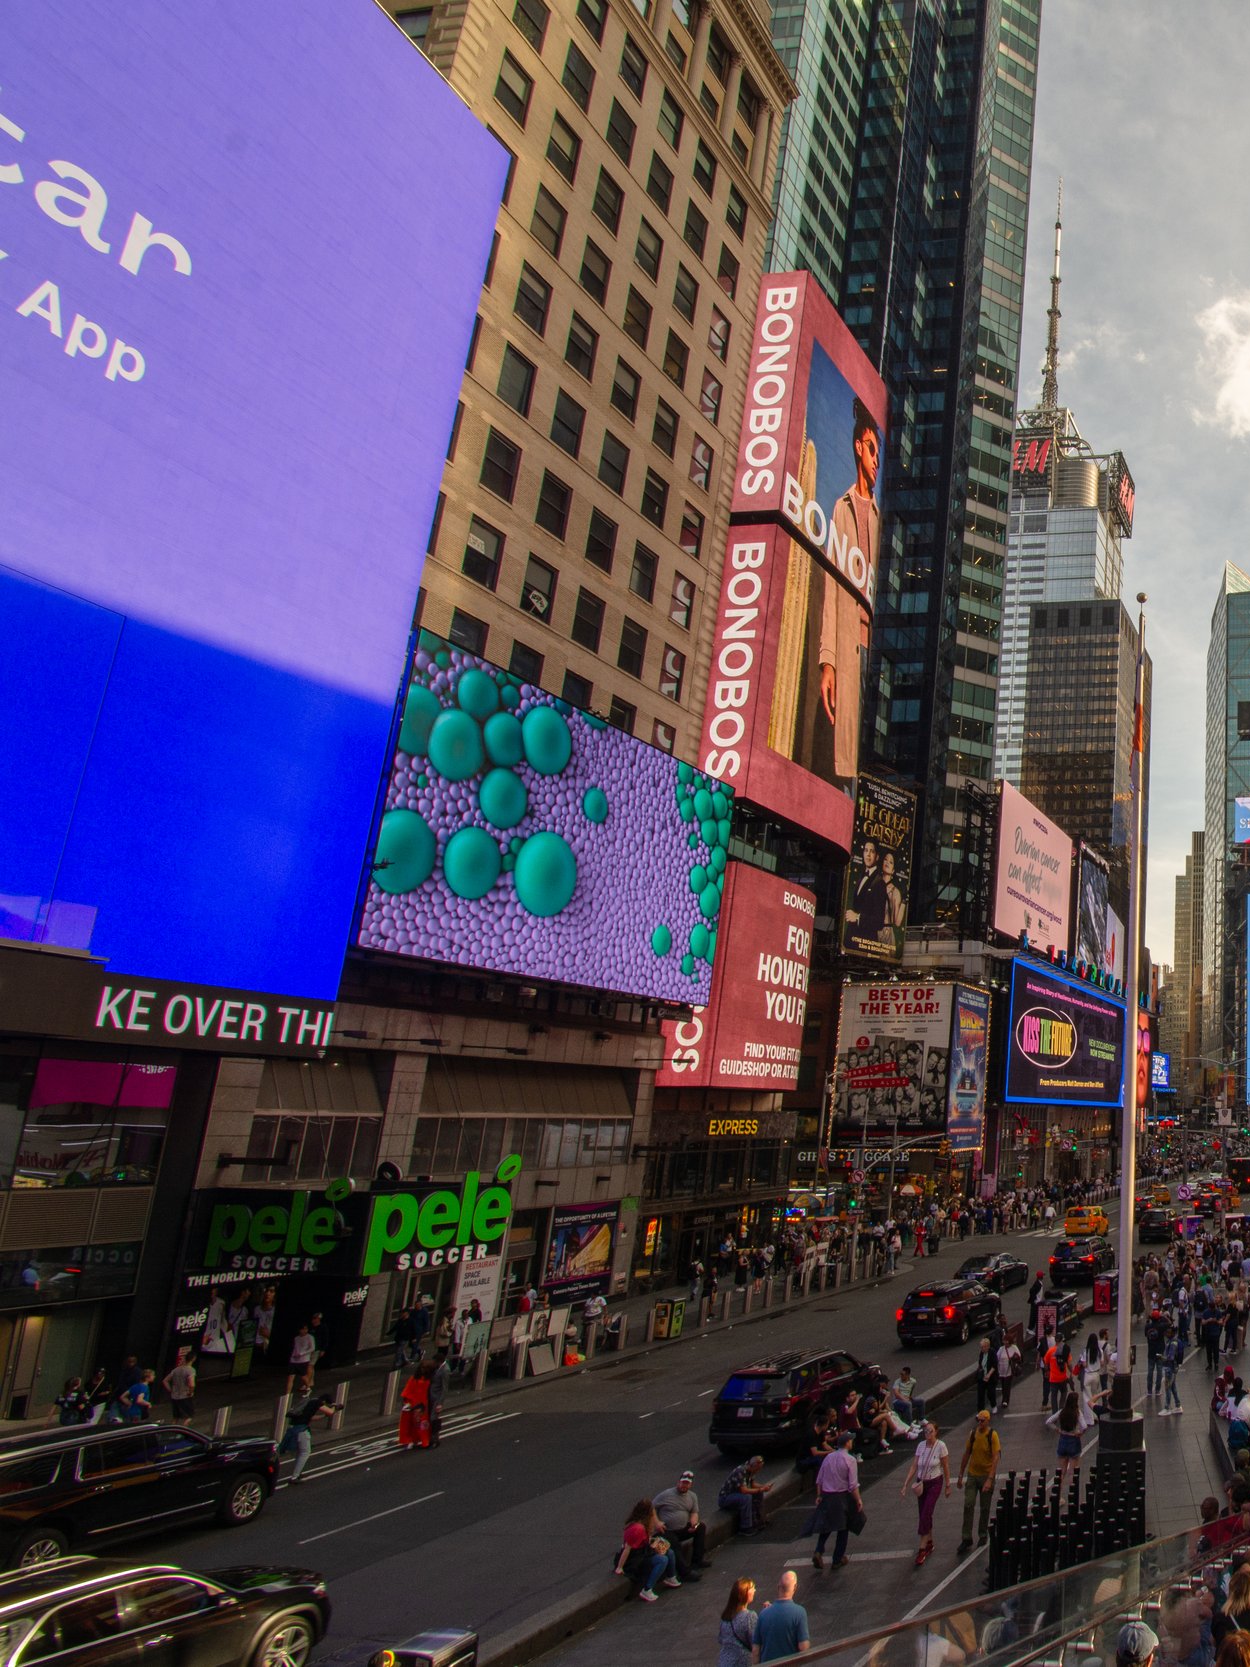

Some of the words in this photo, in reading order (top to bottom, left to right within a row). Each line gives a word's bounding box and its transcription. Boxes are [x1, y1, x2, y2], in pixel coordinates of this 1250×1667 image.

[15, 280, 146, 383] App
[740, 286, 798, 497] BONOBOS
[705, 541, 767, 779] BONOBOS
[878, 808, 910, 832] GREAT
[863, 820, 905, 848] GATSBY
[1015, 826, 1040, 862] Ovarian
[1041, 852, 1061, 874] cancer
[1008, 862, 1022, 882] can
[1022, 862, 1042, 894] affect
[783, 891, 816, 919] BONOBOS
[786, 924, 809, 958] FOR
[765, 991, 796, 1023] YOU
[868, 988, 911, 1001] BEST
[913, 988, 935, 1001] OF
[164, 994, 266, 1043] OVER
[859, 1002, 891, 1015] THE
[893, 1002, 940, 1015] YEAR!
[1023, 1015, 1040, 1053] KISS
[1040, 1018, 1051, 1055] THE
[1050, 1020, 1073, 1057] FUTURE
[743, 1042, 765, 1058] FIND
[765, 1044, 786, 1060] YOUR
[719, 1059, 771, 1076] GUIDESHOP
[771, 1063, 782, 1078] OR
[708, 1119, 758, 1136] EXPRESS
[797, 1151, 836, 1162] GIFS
[847, 1151, 910, 1162] LGGAGE
[232, 1255, 317, 1272] SOCCER
[397, 1243, 489, 1272] SOCCER
[465, 1259, 499, 1271] RESTAURANT
[187, 1275, 210, 1287] THE
[210, 1271, 255, 1285] WORLD'S
[463, 1277, 491, 1288] AVAILABLE
[464, 1270, 481, 1280] SPACE
